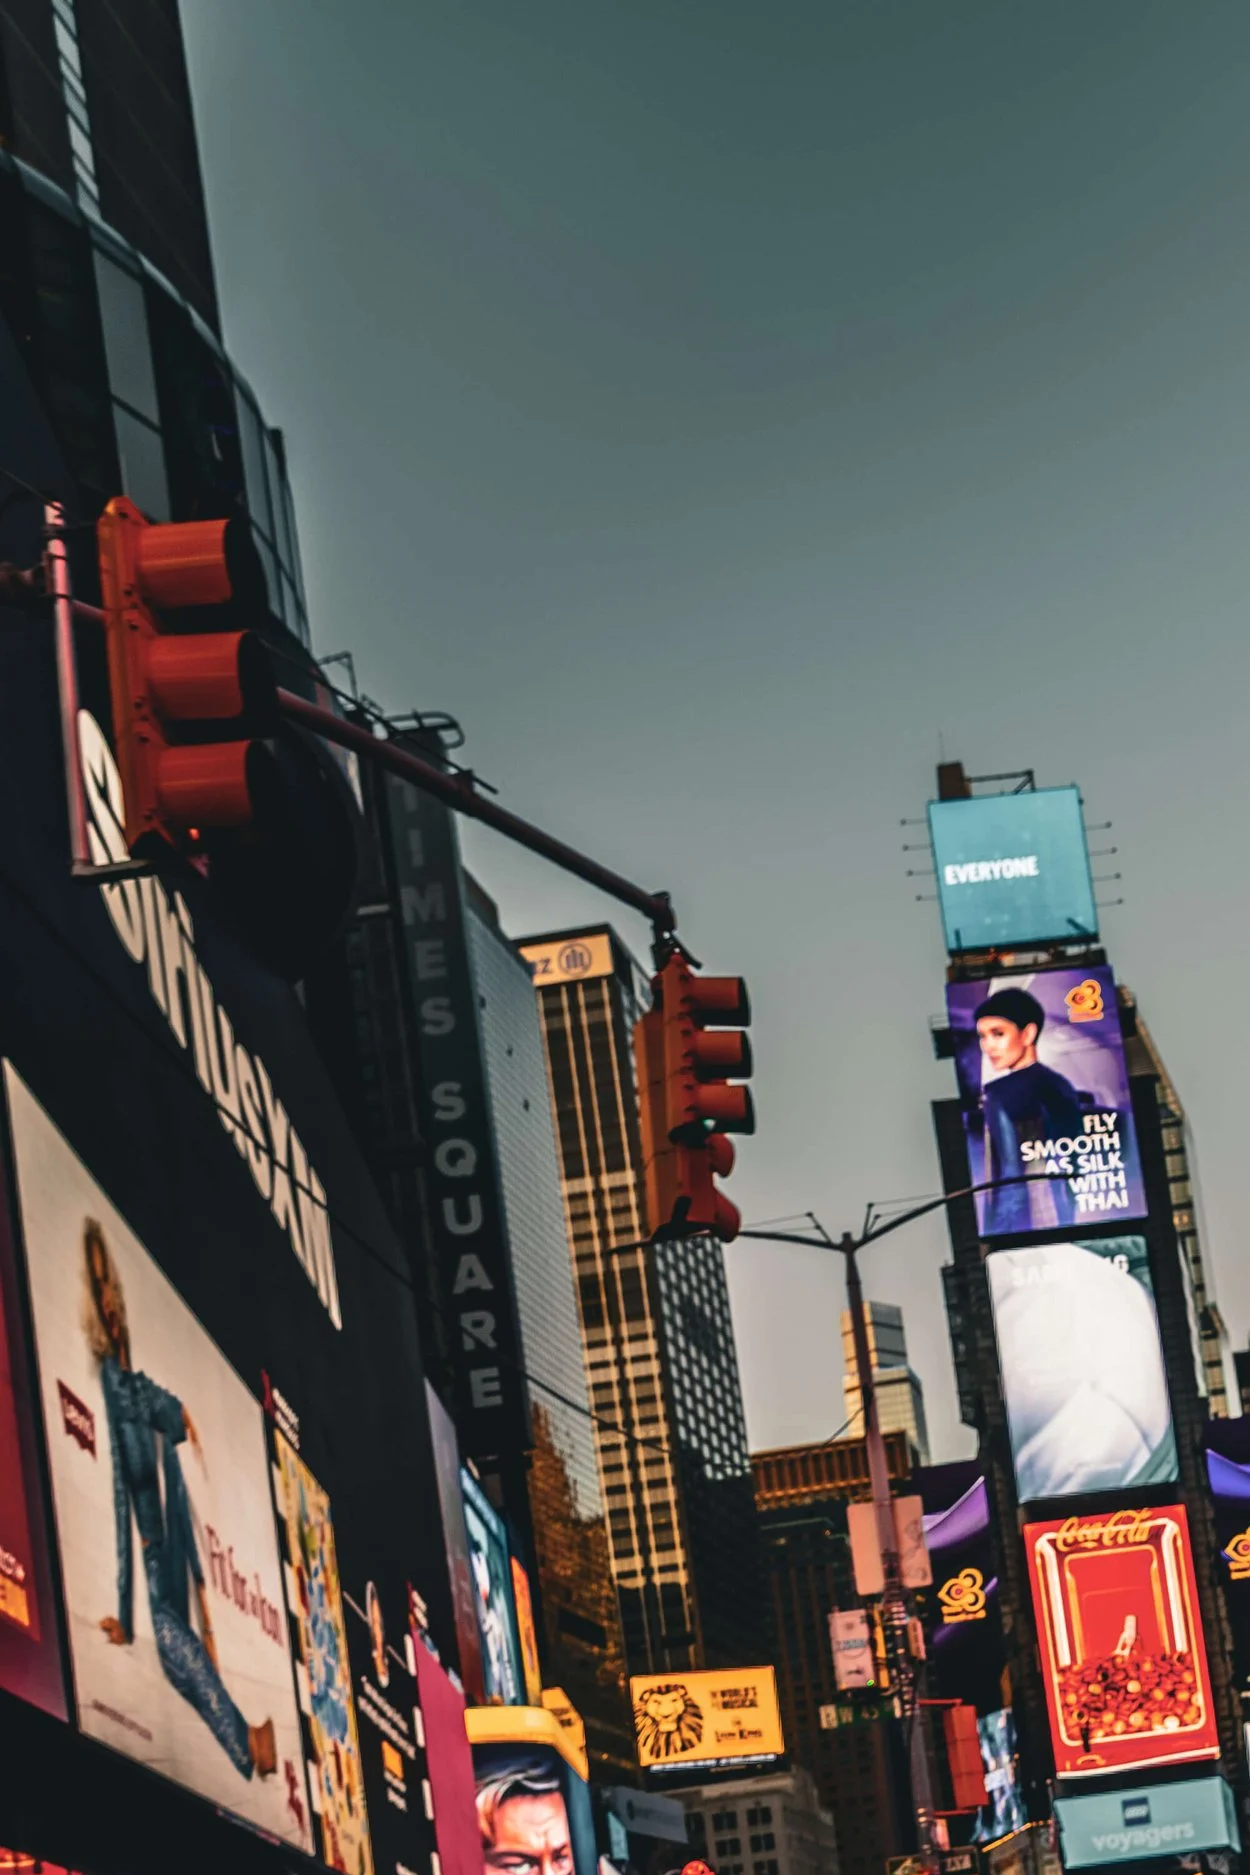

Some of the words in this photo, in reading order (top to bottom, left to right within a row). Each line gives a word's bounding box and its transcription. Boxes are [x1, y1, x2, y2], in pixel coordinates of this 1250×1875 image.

[944, 854, 1040, 886] EVERYONE
[1082, 1112, 1117, 1133] FLY
[1020, 1131, 1120, 1162] SMOOTH
[1044, 1157, 1074, 1176] AS
[1077, 1150, 1125, 1175] SILK
[1067, 1169, 1126, 1194] WITH
[1074, 1188, 1129, 1213] THAI
[431, 1080, 504, 1408] SQUARE
[1091, 1821, 1196, 1853] voyagers
